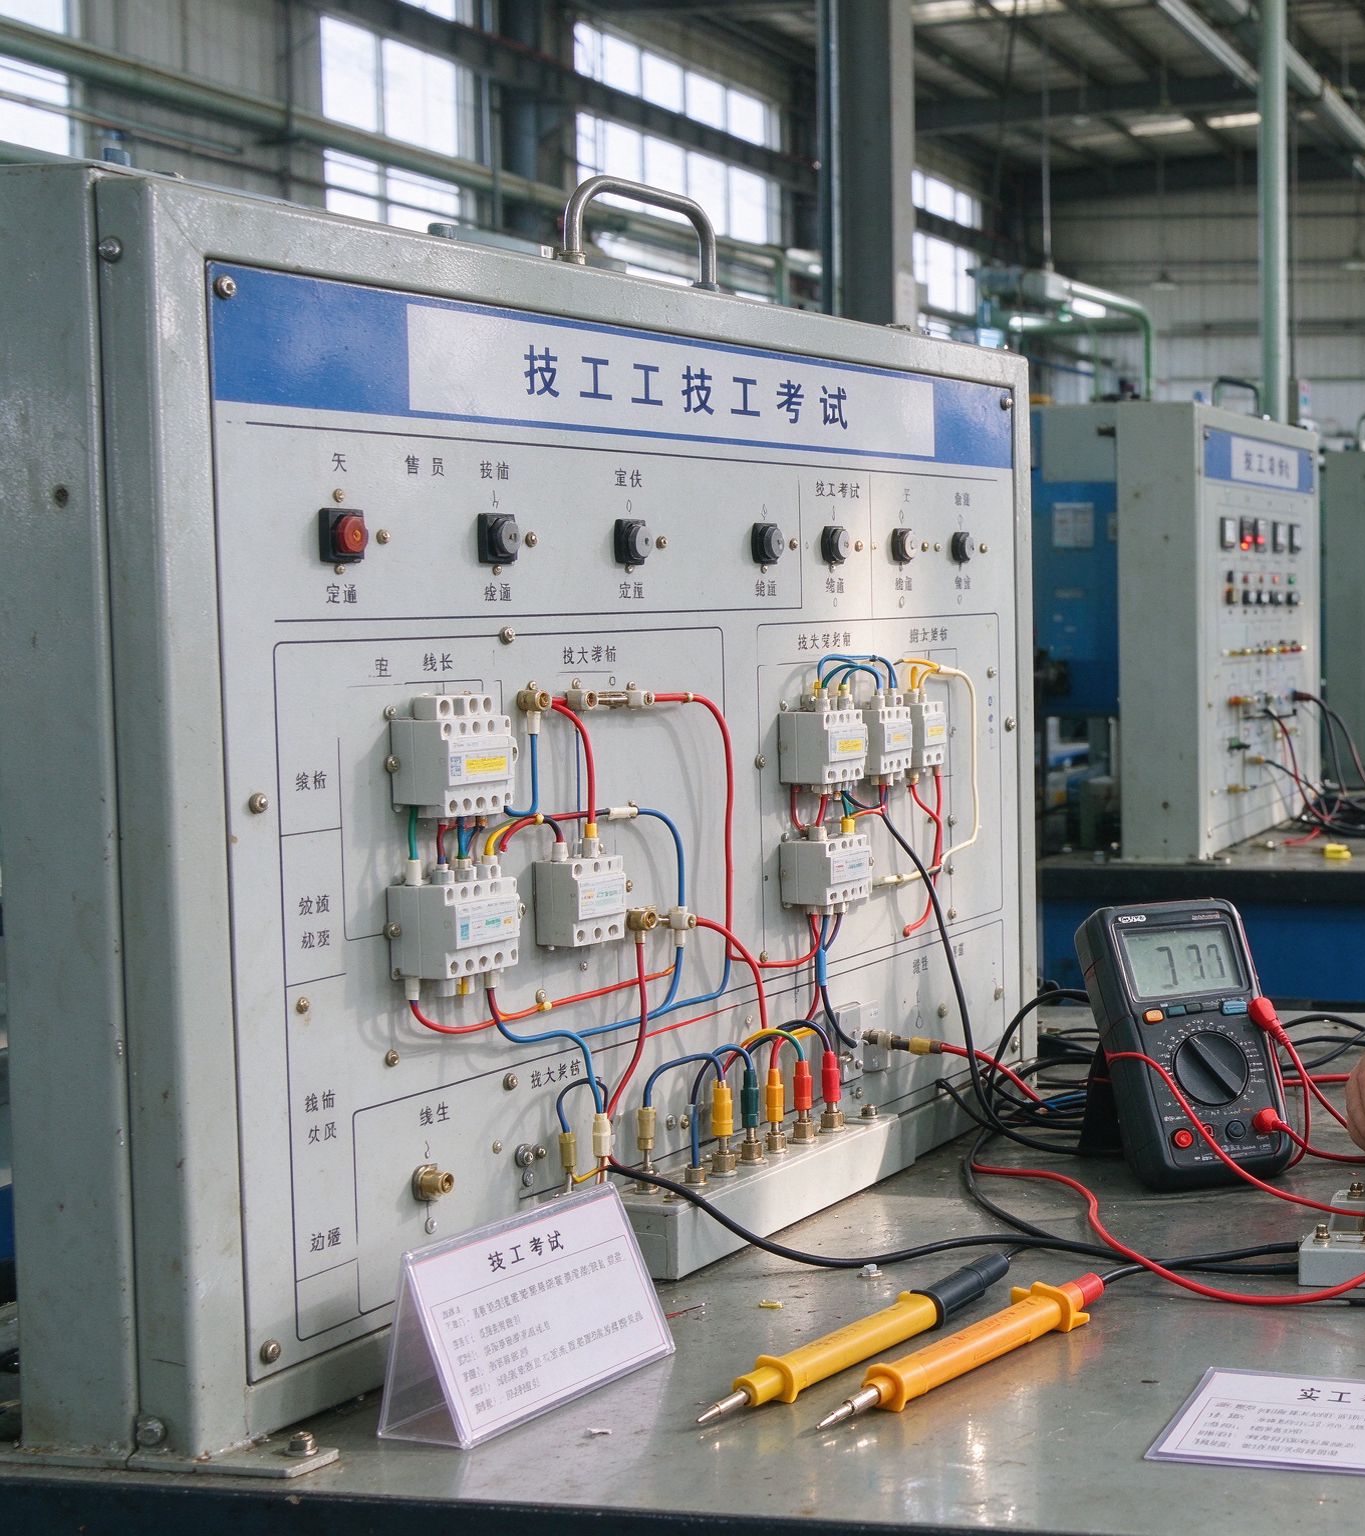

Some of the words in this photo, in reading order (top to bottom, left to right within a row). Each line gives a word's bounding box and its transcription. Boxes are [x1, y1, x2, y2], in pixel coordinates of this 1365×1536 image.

[523, 345, 848, 430] 技工工技工考试
[488, 1230, 564, 1273] 技工考试
